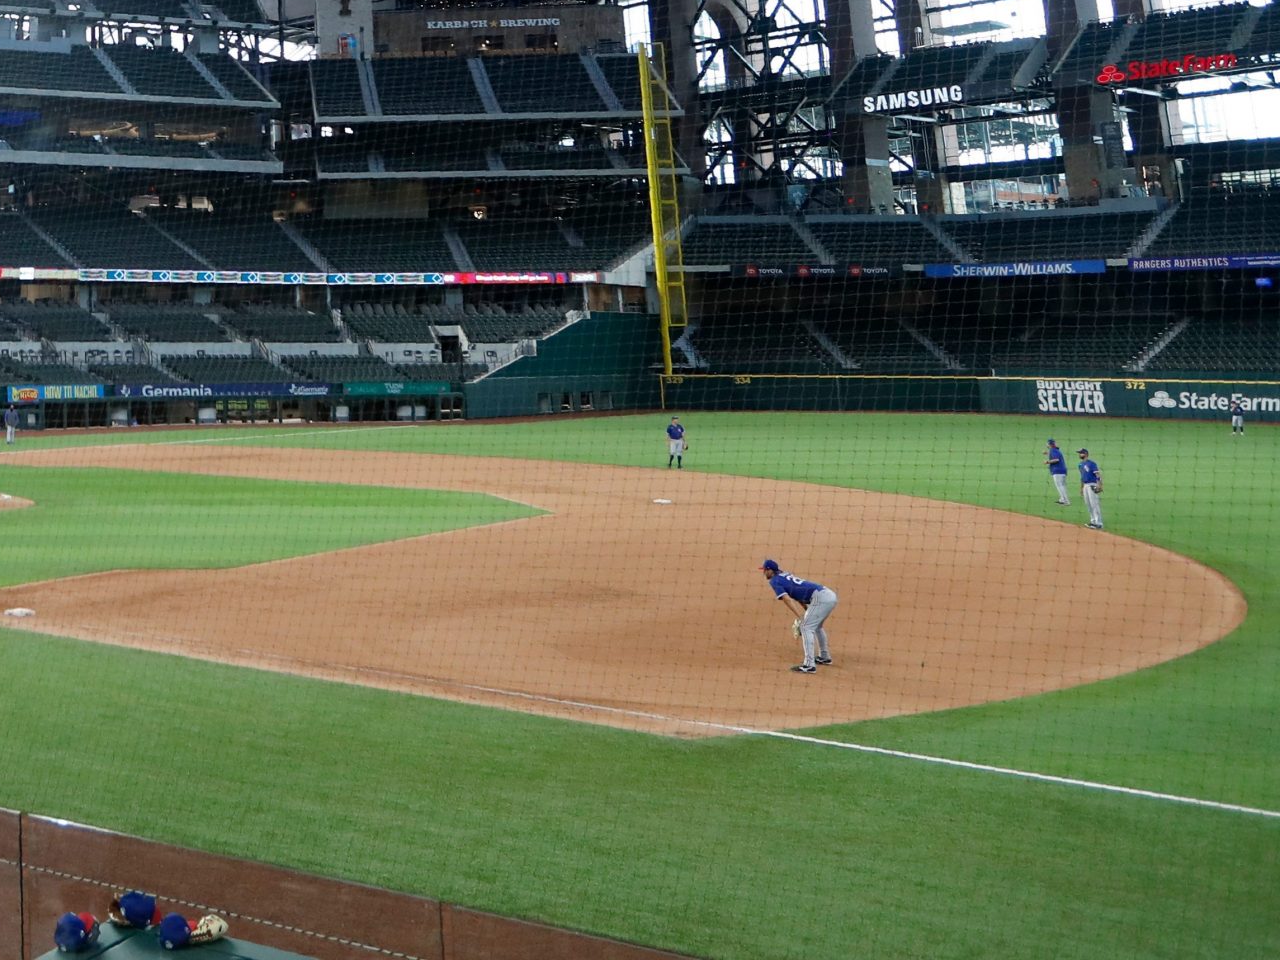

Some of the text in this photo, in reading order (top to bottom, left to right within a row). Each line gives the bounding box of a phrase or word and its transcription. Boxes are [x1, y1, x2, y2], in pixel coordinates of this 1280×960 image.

[427, 18, 561, 29] KARBACH BREWING
[1128, 53, 1237, 81] State Farm
[863, 85, 963, 114] SAMSUNG
[1133, 260, 1171, 270] RANGERS
[1174, 258, 1229, 268] AUTHENTICS
[44, 386, 61, 399] HOW
[64, 385, 72, 398] TO
[142, 384, 212, 397] Germania
[1036, 380, 1102, 391] BUD LIGHT
[1125, 381, 1146, 390] 372
[1038, 390, 1106, 413] SELTZER
[1179, 392, 1280, 411] State Farm
